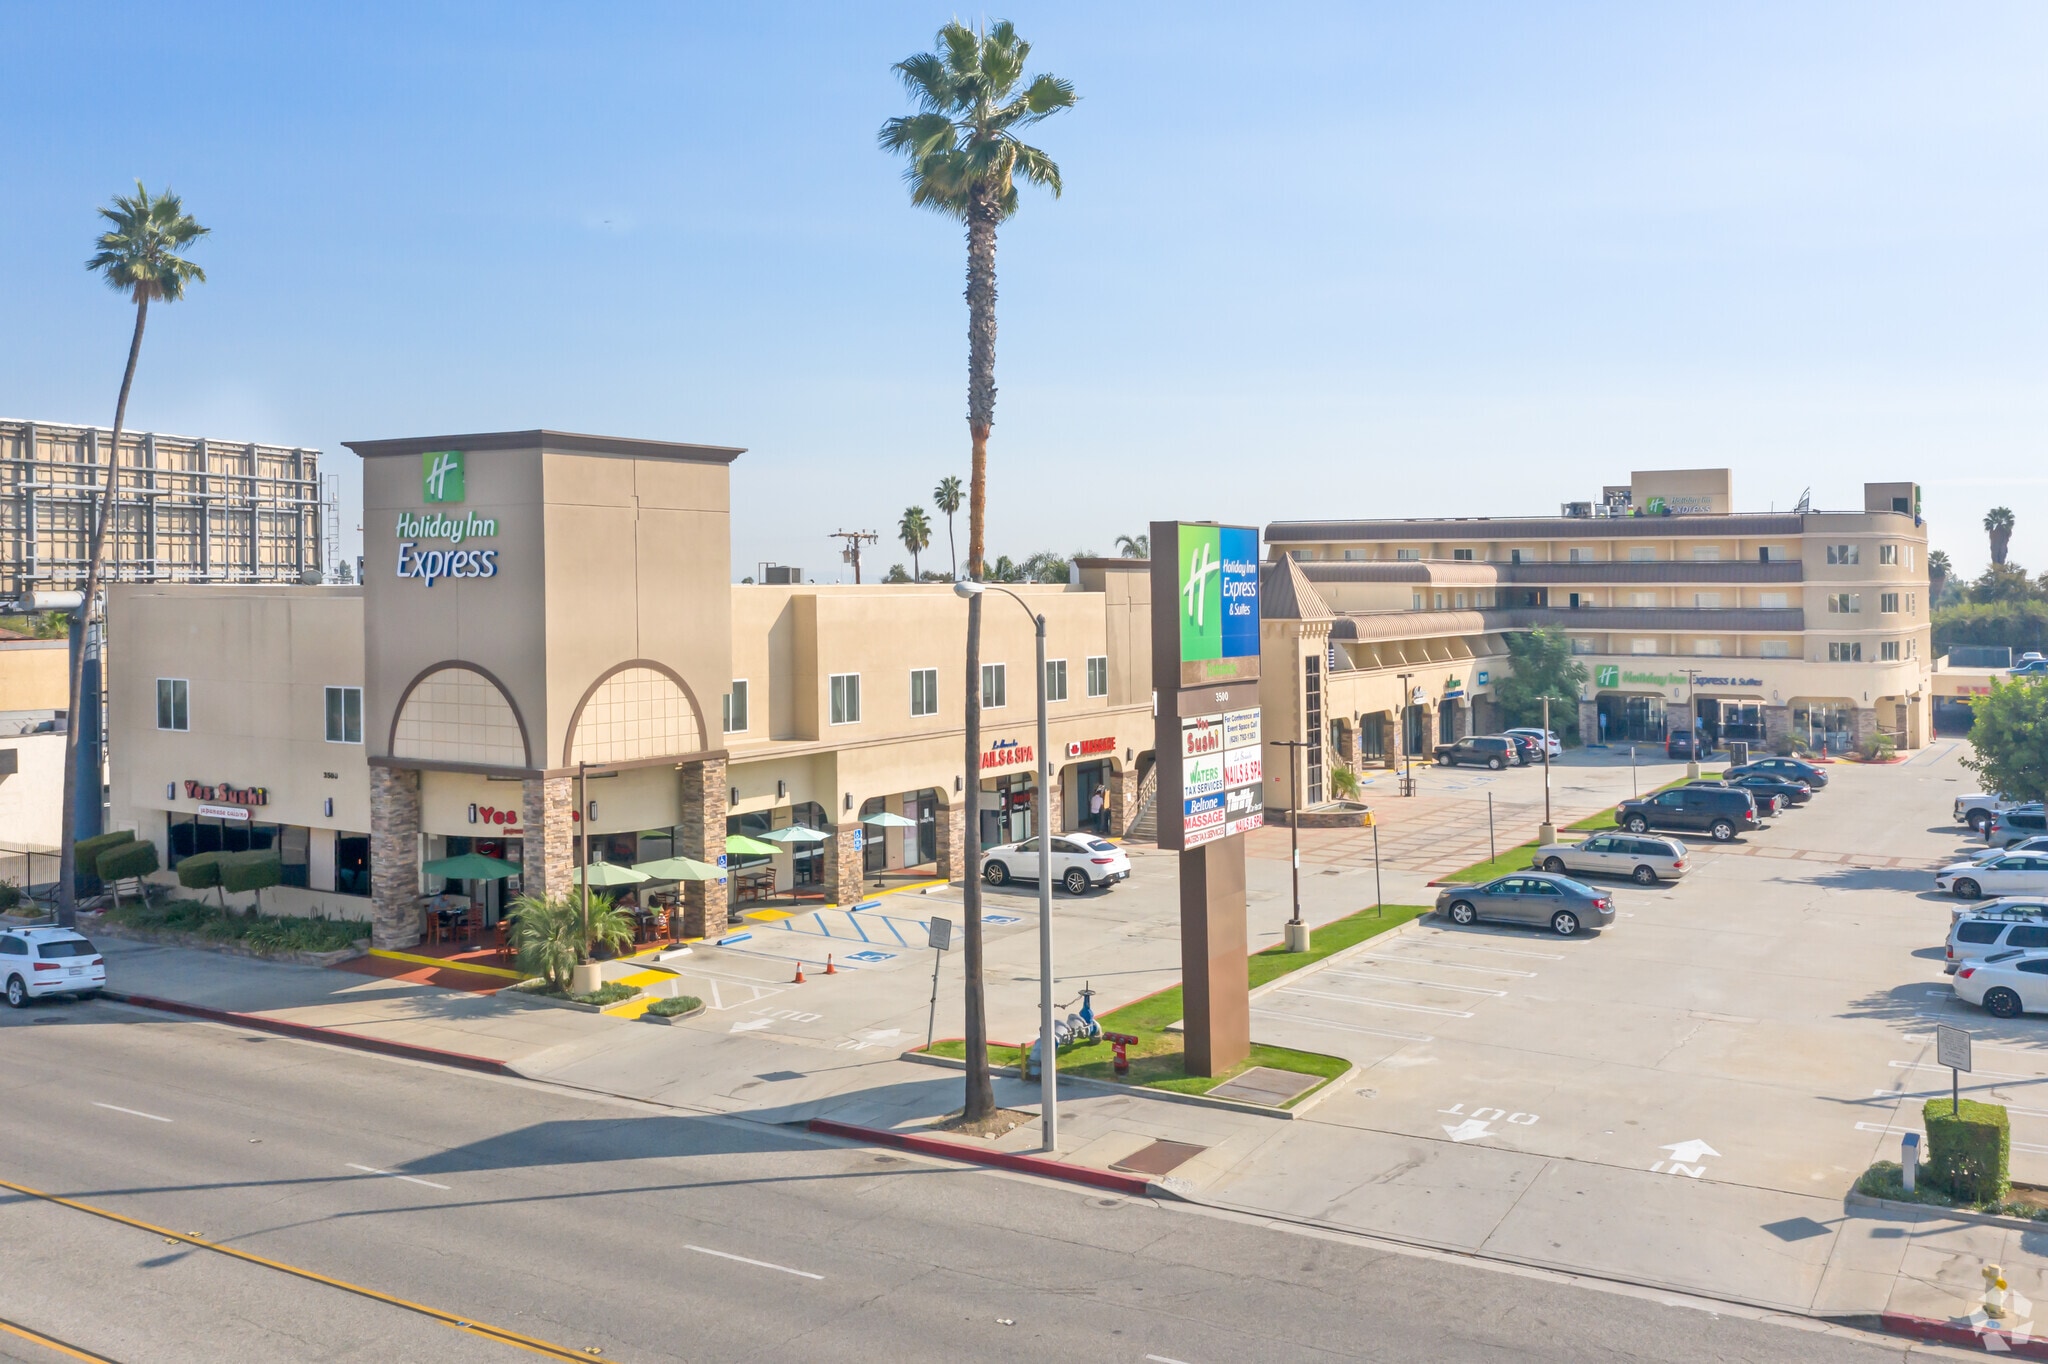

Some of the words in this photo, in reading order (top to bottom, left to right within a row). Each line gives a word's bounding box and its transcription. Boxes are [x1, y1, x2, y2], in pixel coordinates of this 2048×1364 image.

[396, 512, 465, 543] Holiday
[466, 511, 499, 537] Inn
[396, 542, 498, 587] Express
[1223, 558, 1246, 577] Holiday
[1246, 559, 1256, 574] Inn
[1223, 577, 1256, 601] Express
[1234, 603, 1251, 615] Suites
[1622, 671, 1667, 687] Holiday
[1668, 672, 1687, 684] Inn
[1738, 677, 1763, 686] Suites
[1196, 717, 1209, 731] Yes
[1187, 728, 1219, 754] Sushi
[979, 750, 1006, 770] AILS
[1006, 749, 1014, 765] &
[1014, 745, 1034, 764] SPA
[1190, 760, 1219, 784] WATERS
[1225, 764, 1244, 786] NAILS
[1250, 760, 1262, 780] SPA
[184, 779, 215, 801] Yes
[218, 782, 267, 806] Sushi
[1185, 786, 1196, 796] TAX
[1198, 780, 1223, 793] SERVICES
[1191, 797, 1218, 813] Beltone
[479, 806, 517, 825] Yes
[1184, 810, 1223, 830] MASSAGE
[750, 1006, 824, 1023] OUT
[1437, 1103, 1540, 1126] OUT
[1650, 1160, 1706, 1178] IN
